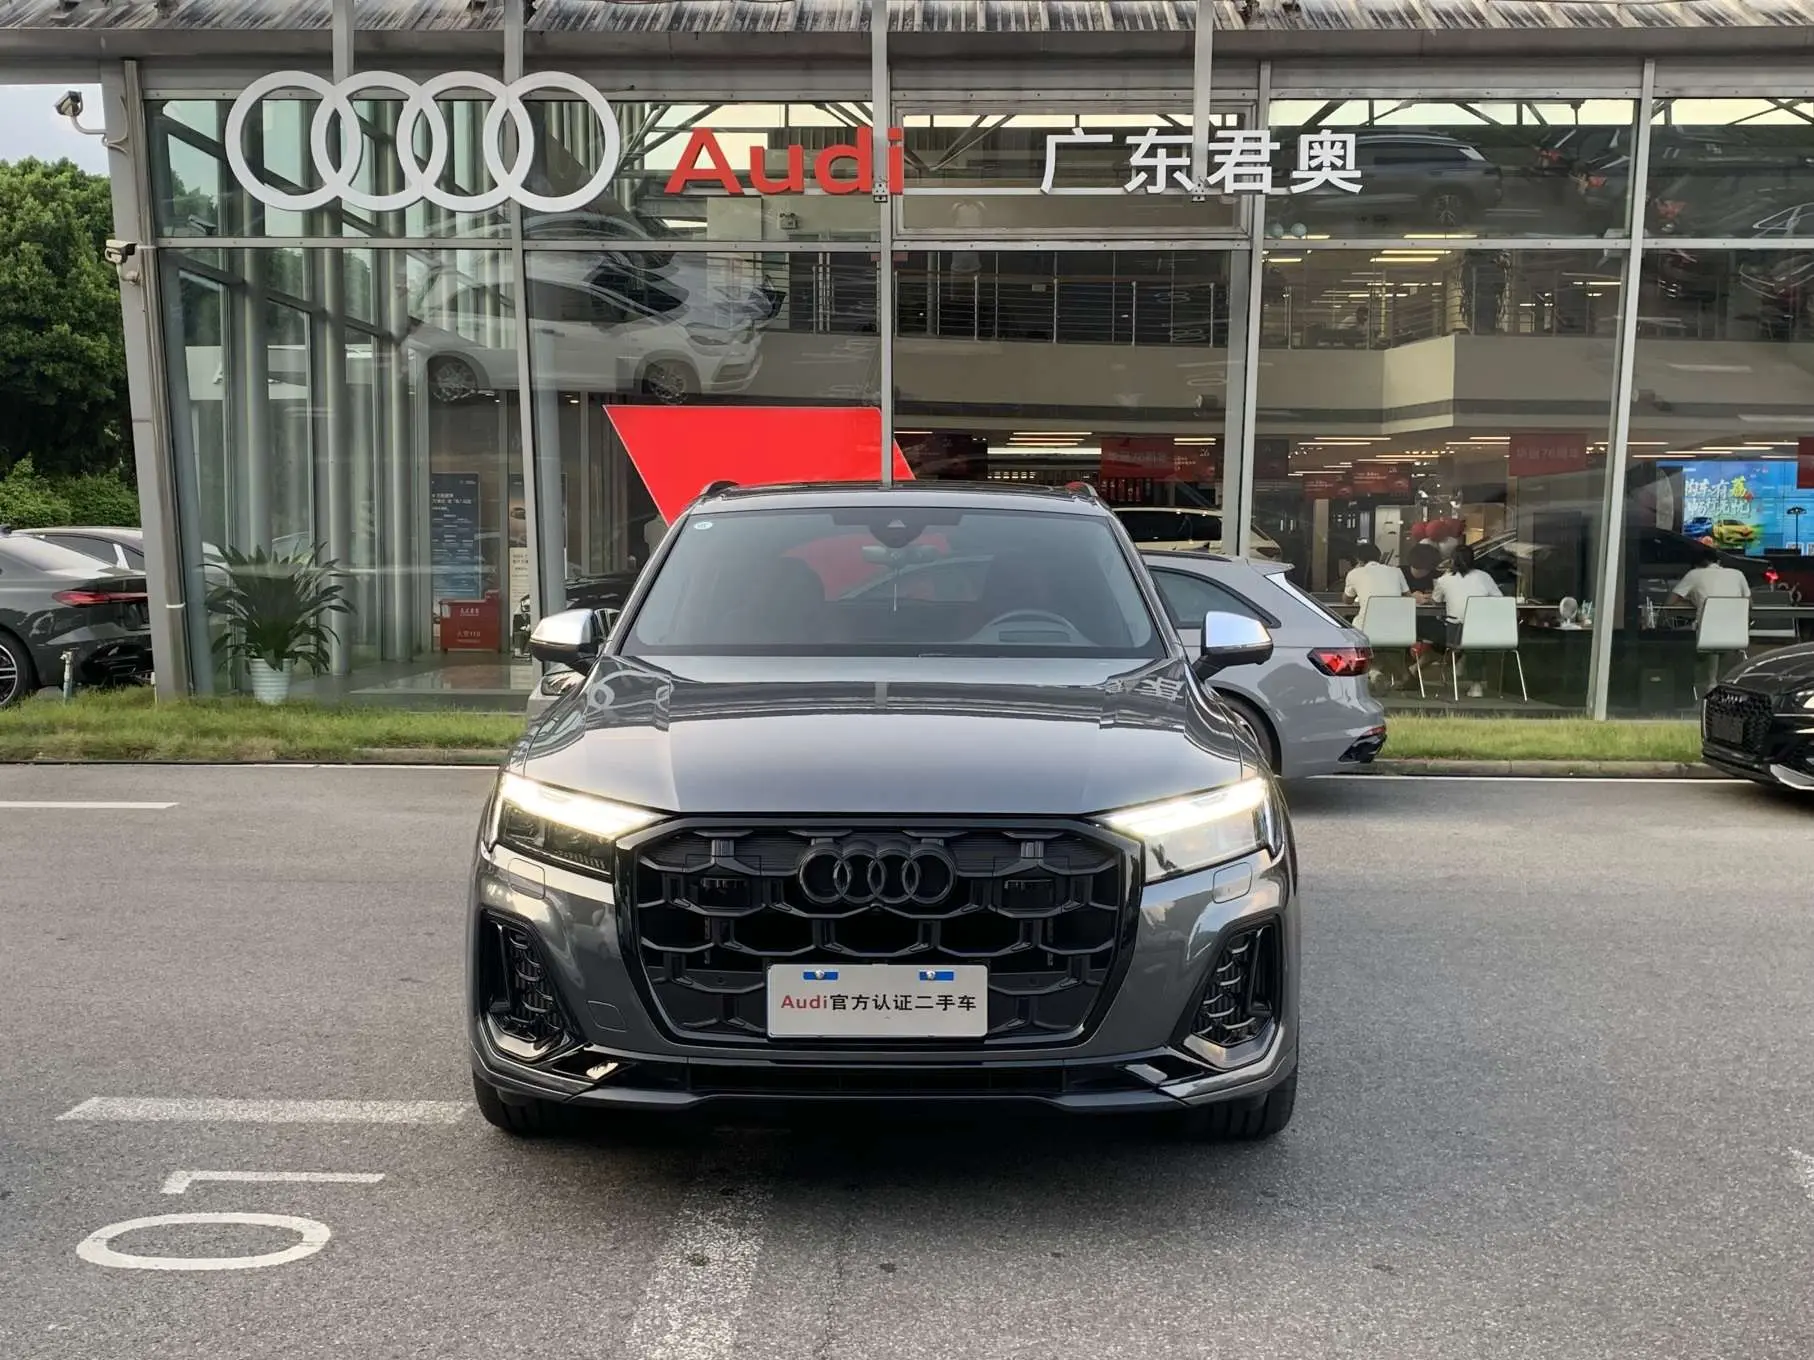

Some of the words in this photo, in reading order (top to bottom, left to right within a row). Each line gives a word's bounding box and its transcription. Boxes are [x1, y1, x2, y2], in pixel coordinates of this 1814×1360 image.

[664, 125, 904, 196] Audi
[1040, 127, 1363, 195] 广东君奥
